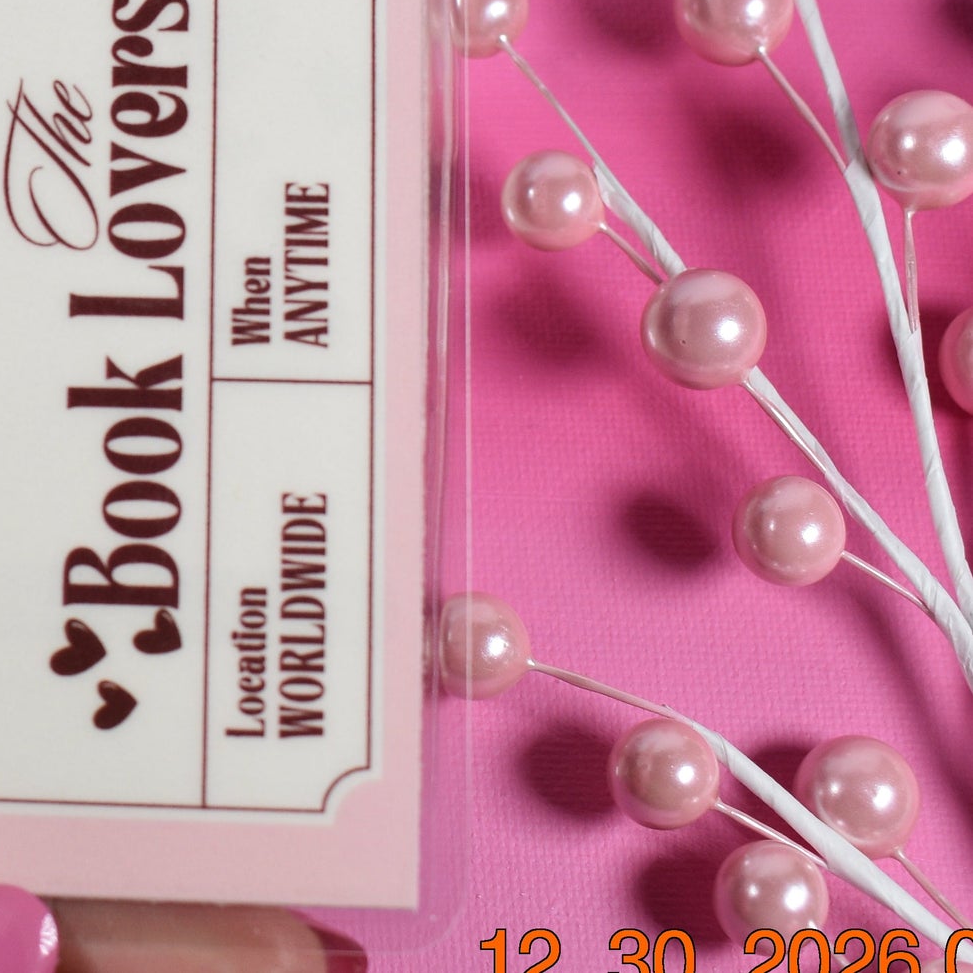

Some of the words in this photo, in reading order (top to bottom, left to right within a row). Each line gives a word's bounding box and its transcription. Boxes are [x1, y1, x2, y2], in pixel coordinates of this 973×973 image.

[3, 77, 100, 252] The
[230, 256, 272, 347] When
[283, 181, 330, 349] ANYTIME
[62, 353, 184, 609] Book
[225, 586, 269, 739] Location
[278, 492, 328, 740] WORLDWIDE
